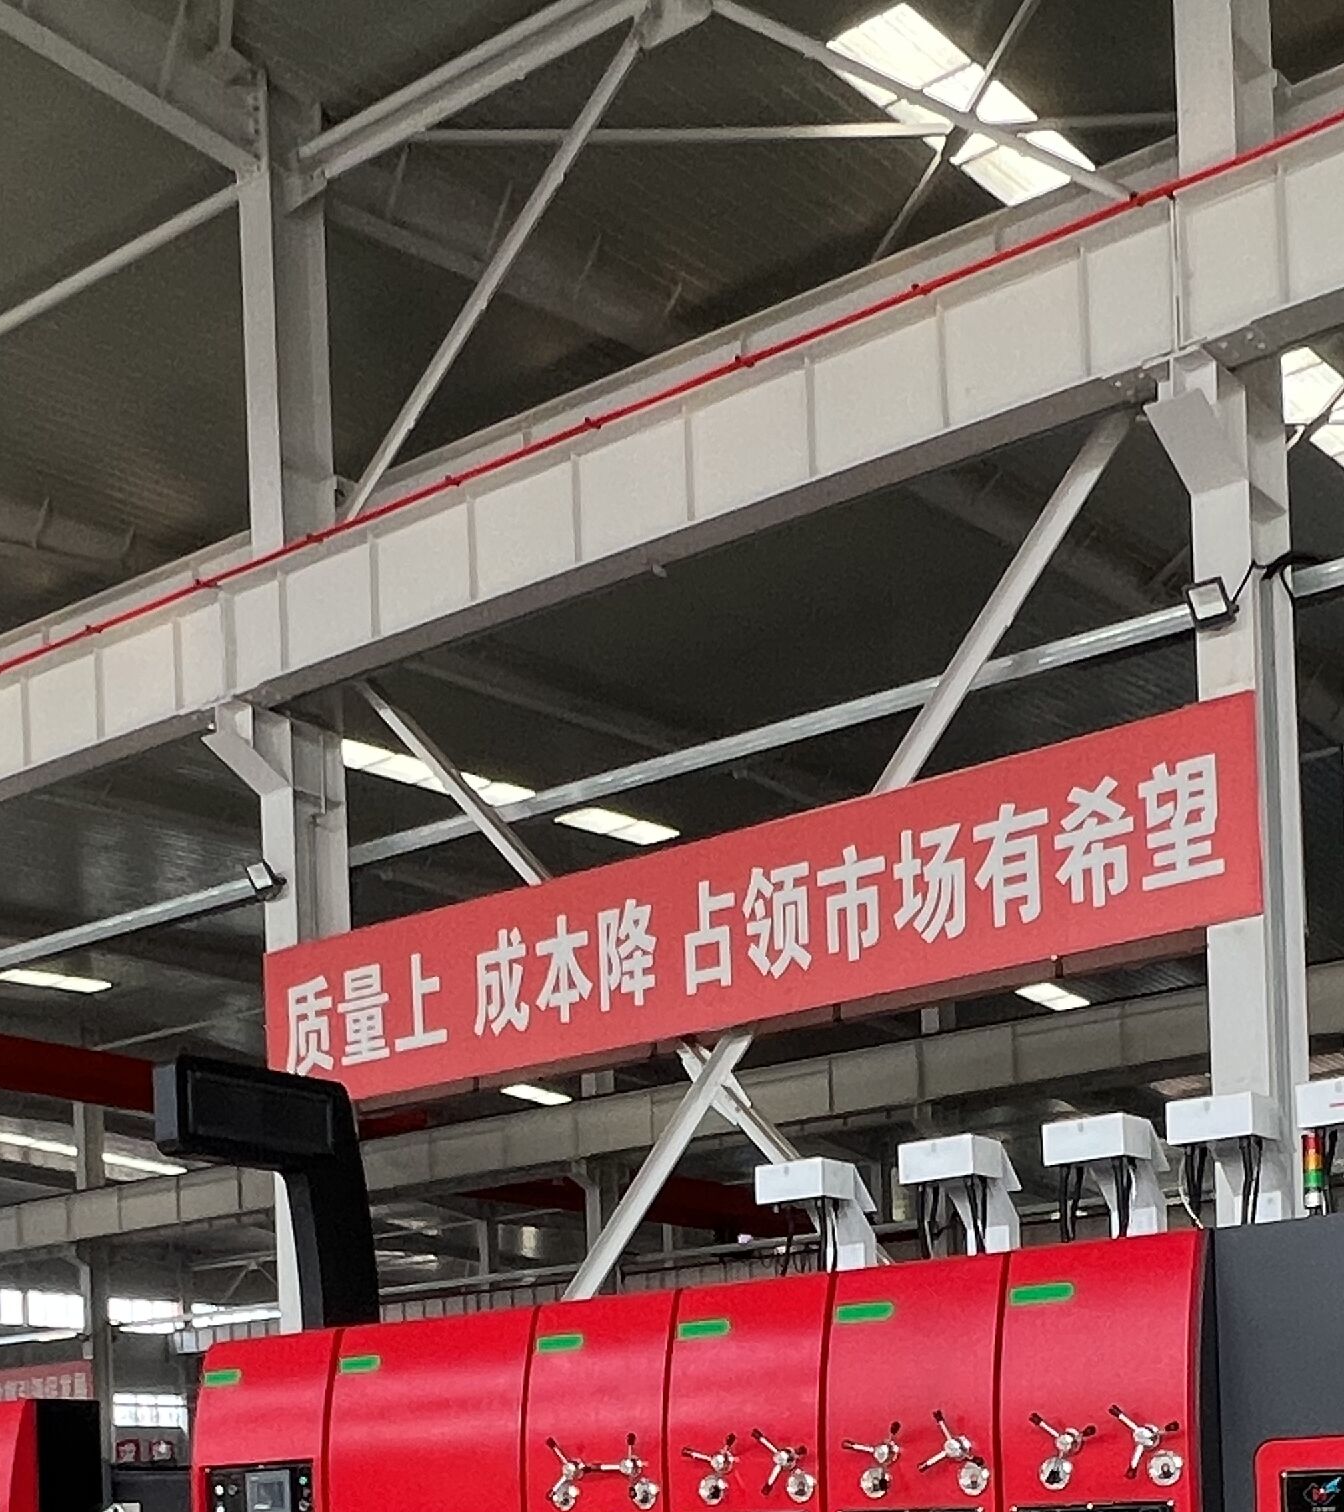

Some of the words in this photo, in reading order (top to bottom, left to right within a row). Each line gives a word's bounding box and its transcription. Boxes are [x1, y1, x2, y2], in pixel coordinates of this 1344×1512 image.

[286, 952, 448, 1077] 质量上
[475, 896, 656, 1038] 成本降
[684, 753, 1227, 997] 占领市场有希望
